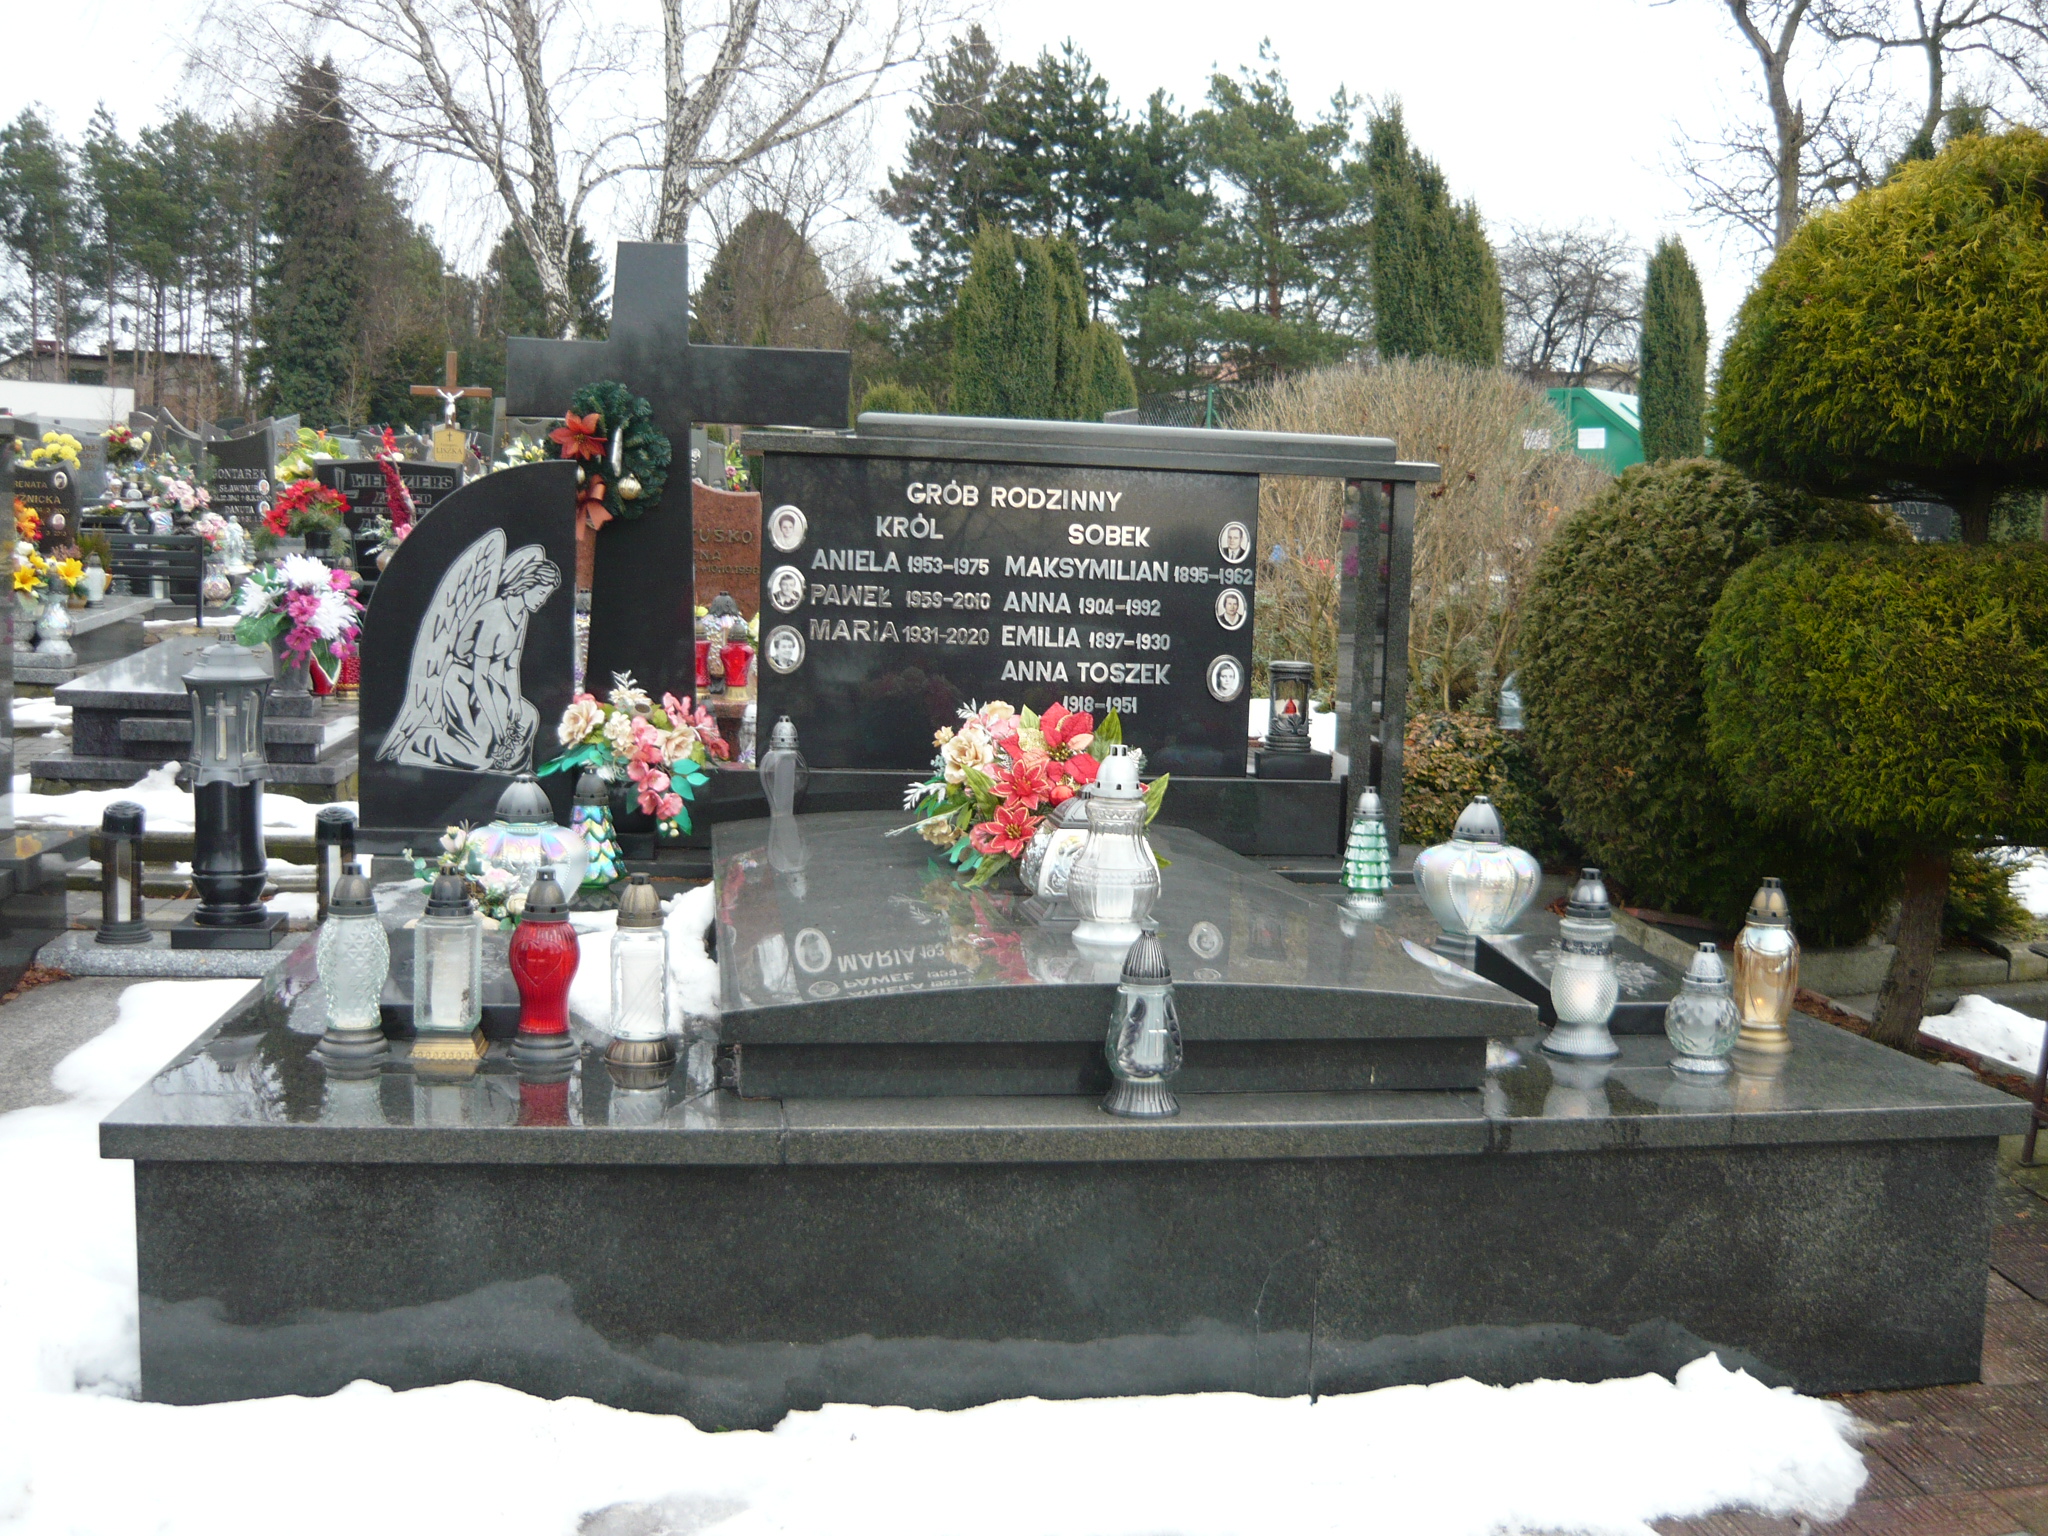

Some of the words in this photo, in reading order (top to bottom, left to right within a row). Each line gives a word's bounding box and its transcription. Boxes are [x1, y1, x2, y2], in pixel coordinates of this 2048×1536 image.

[907, 479, 980, 507] GRÓB
[991, 486, 1123, 512] RODZINNY
[694, 529, 753, 543] USKO
[876, 512, 944, 540] KRÓL
[1068, 523, 1151, 547] SOBEK
[811, 548, 901, 573] ANIELA
[908, 555, 990, 576] 1953-1975
[1004, 555, 1169, 582] MAKSYMILIAN
[1174, 565, 1253, 585] 1895-1962
[810, 583, 893, 608] PAWEŁ
[906, 590, 991, 610] 1959-2010
[1003, 591, 1072, 614] ANNA
[1079, 597, 1161, 616] 1904-1992
[809, 618, 900, 643] MARIA
[902, 625, 990, 645] 1931-2020
[1001, 625, 1081, 648] EMILIA
[1089, 631, 1171, 650] 1897-1930
[1001, 660, 1069, 683] ANNA
[1077, 661, 1171, 685] TOSZEK
[1062, 695, 1137, 714] 1918-1951
